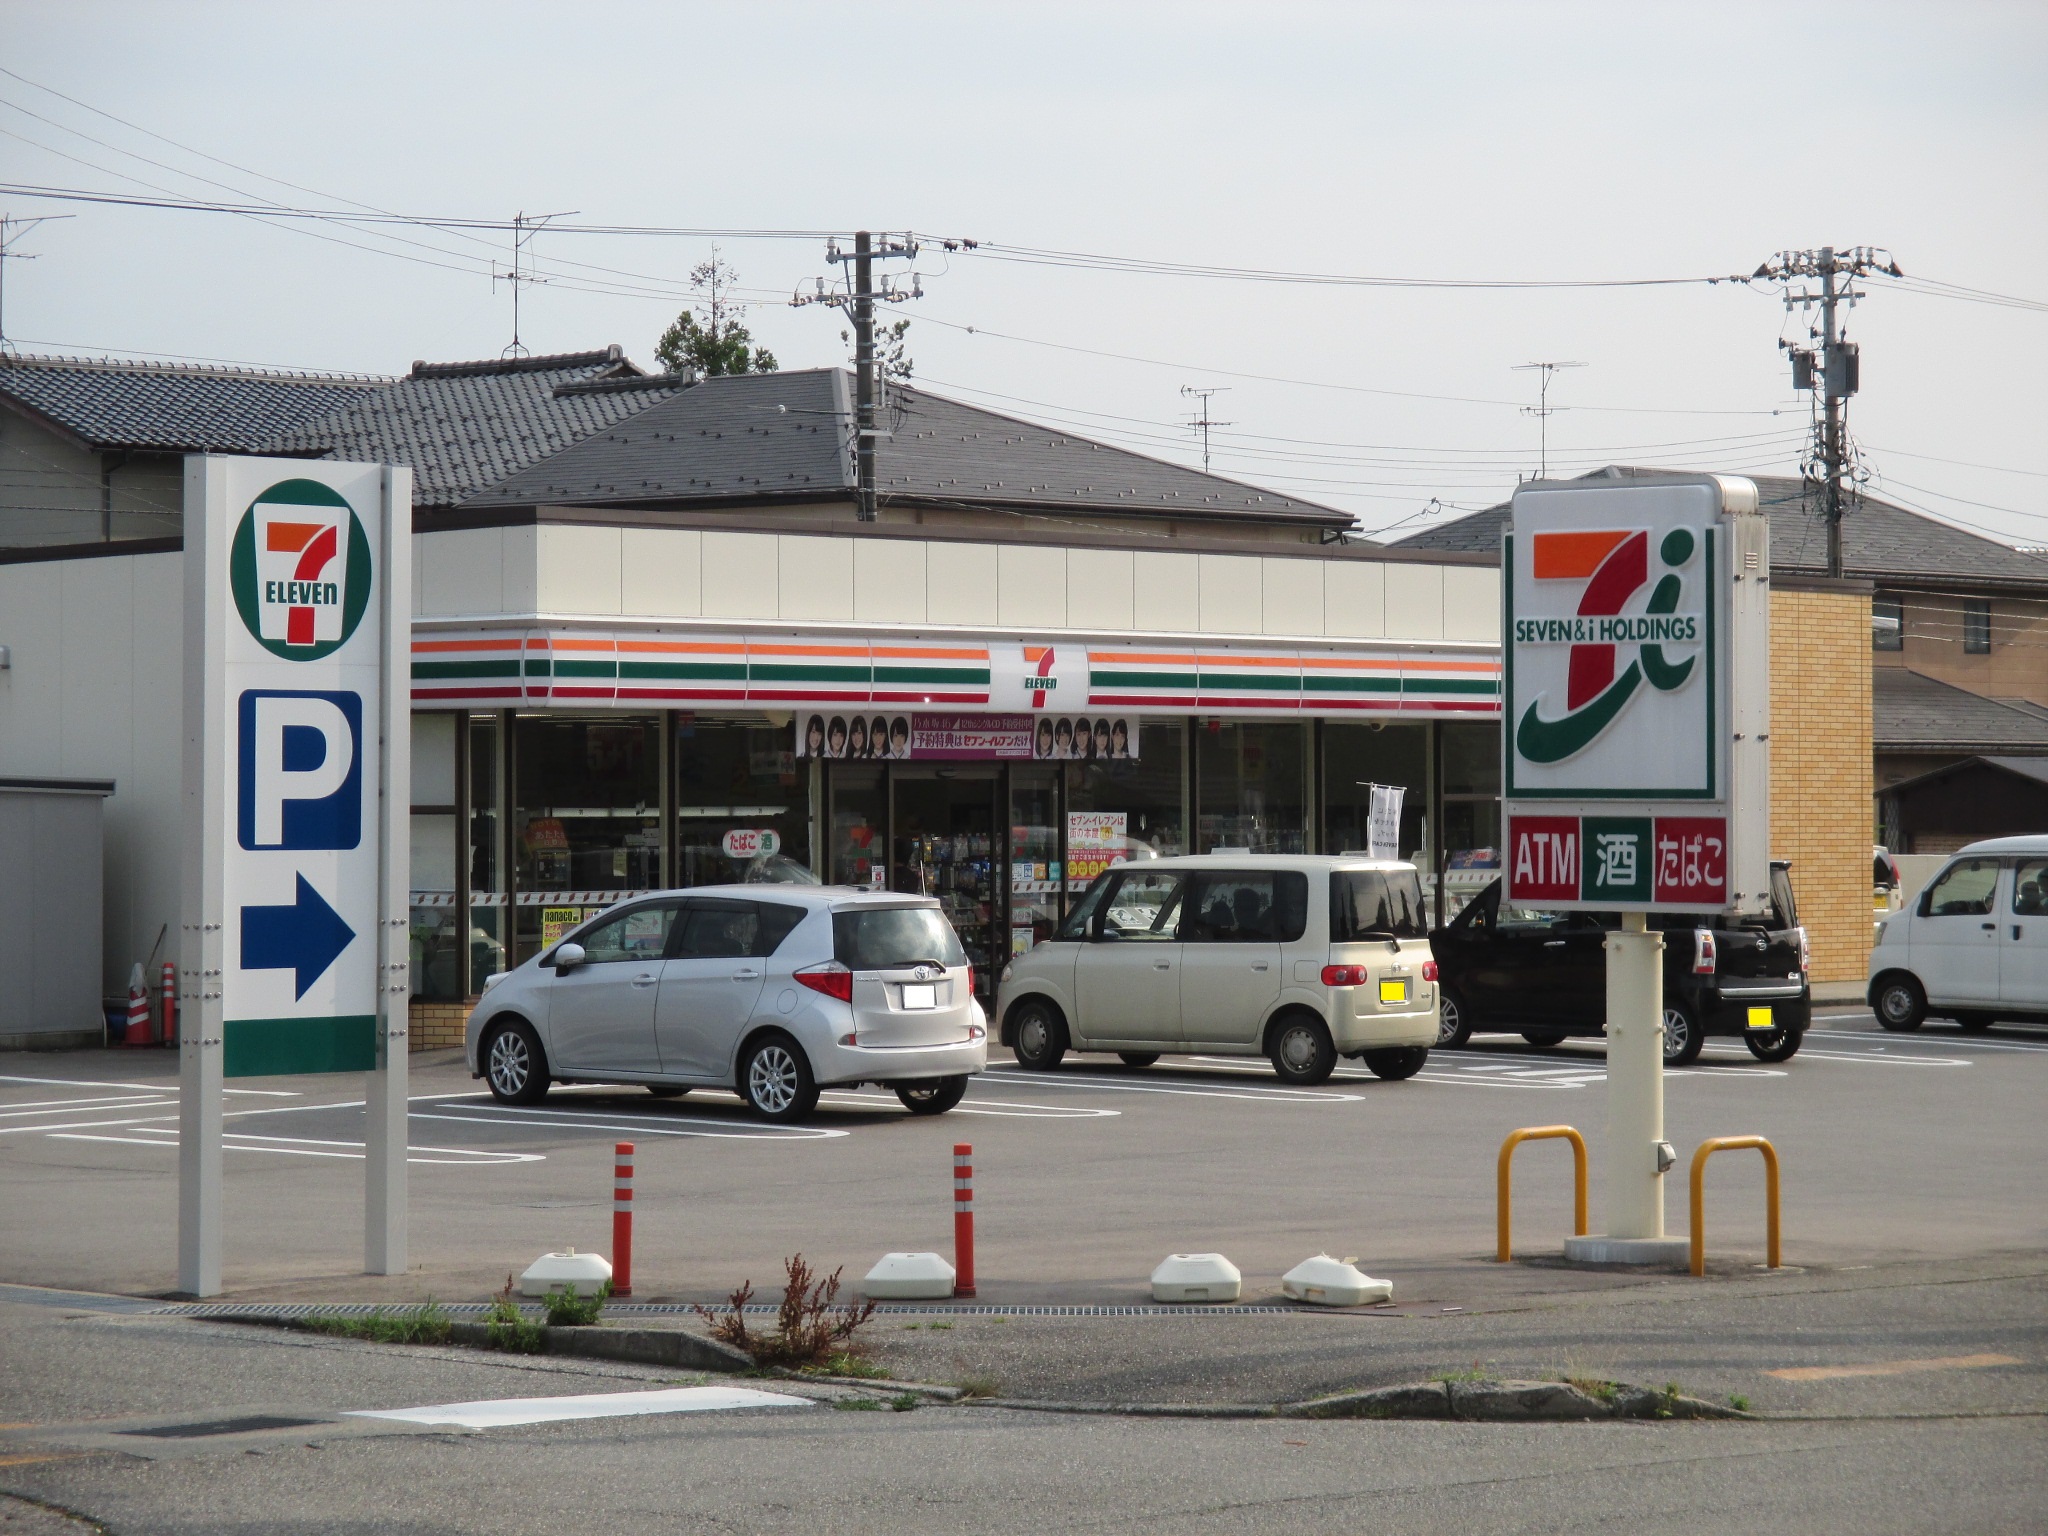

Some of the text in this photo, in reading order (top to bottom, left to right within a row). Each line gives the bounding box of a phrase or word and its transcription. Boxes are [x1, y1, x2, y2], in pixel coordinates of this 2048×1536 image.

[266, 521, 338, 645] 7
[1599, 616, 1696, 643] HOLDINGS
[1023, 646, 1056, 708] 7
[254, 696, 354, 846] P
[729, 833, 773, 851] たばこ 酒
[1514, 832, 1725, 889] ATM 酒 たばこ
[544, 911, 573, 922] nanaco
